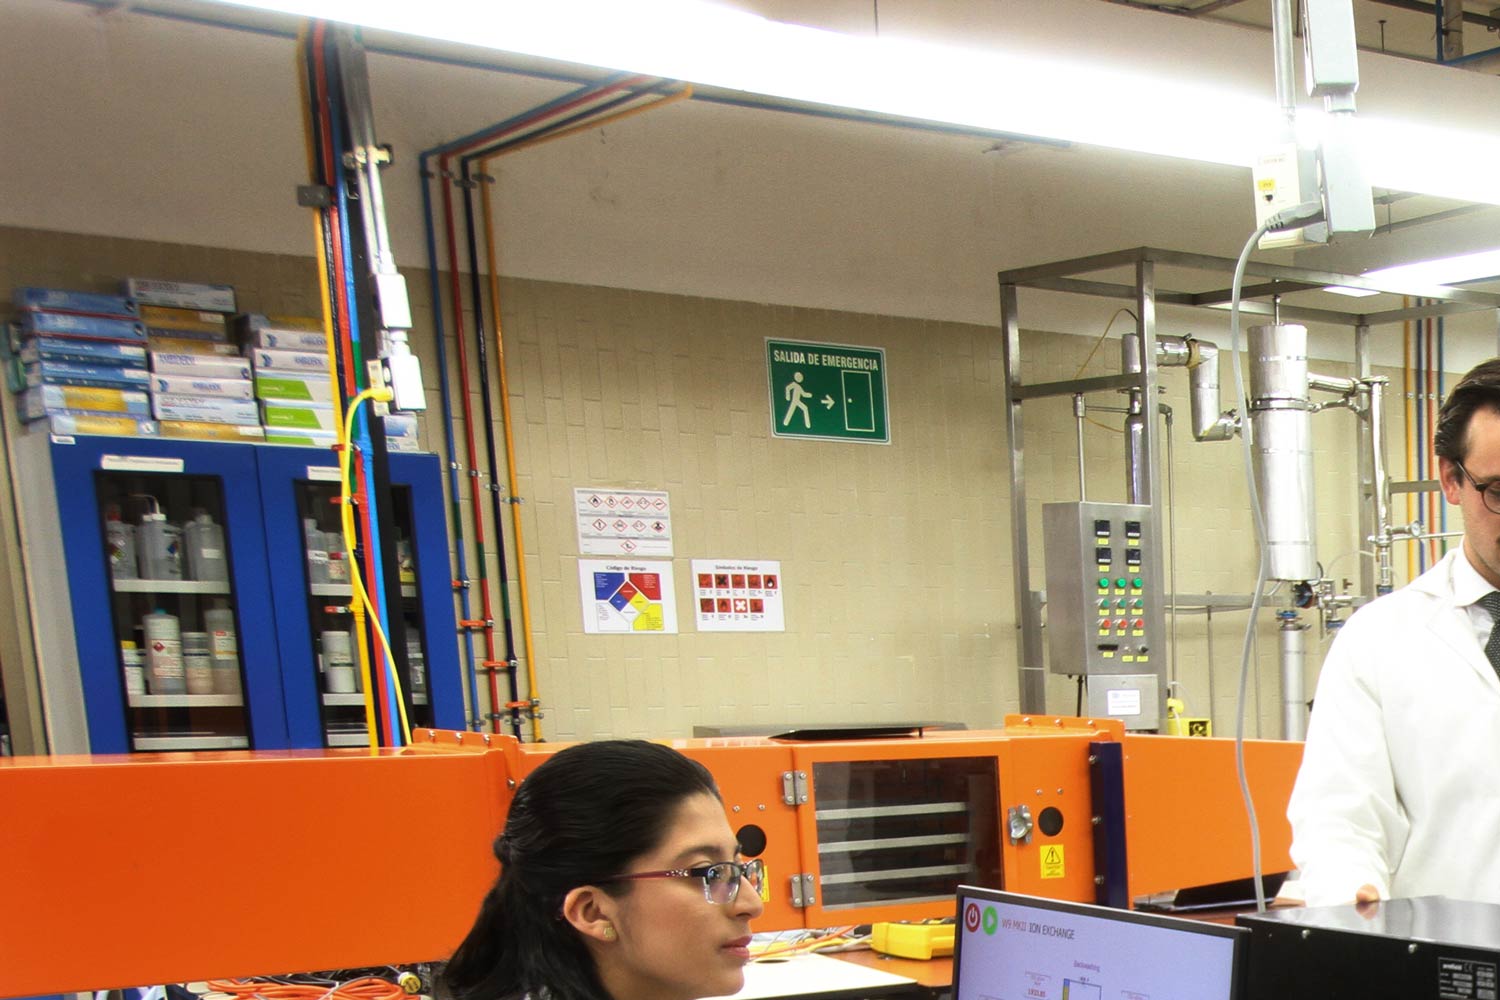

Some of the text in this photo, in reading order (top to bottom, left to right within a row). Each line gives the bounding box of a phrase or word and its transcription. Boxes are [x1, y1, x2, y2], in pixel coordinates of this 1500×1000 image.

[774, 350, 878, 371] SALIDA DE EMERGENCIA
[1001, 919, 1075, 940] W9 MKII ION EXCHANGE
